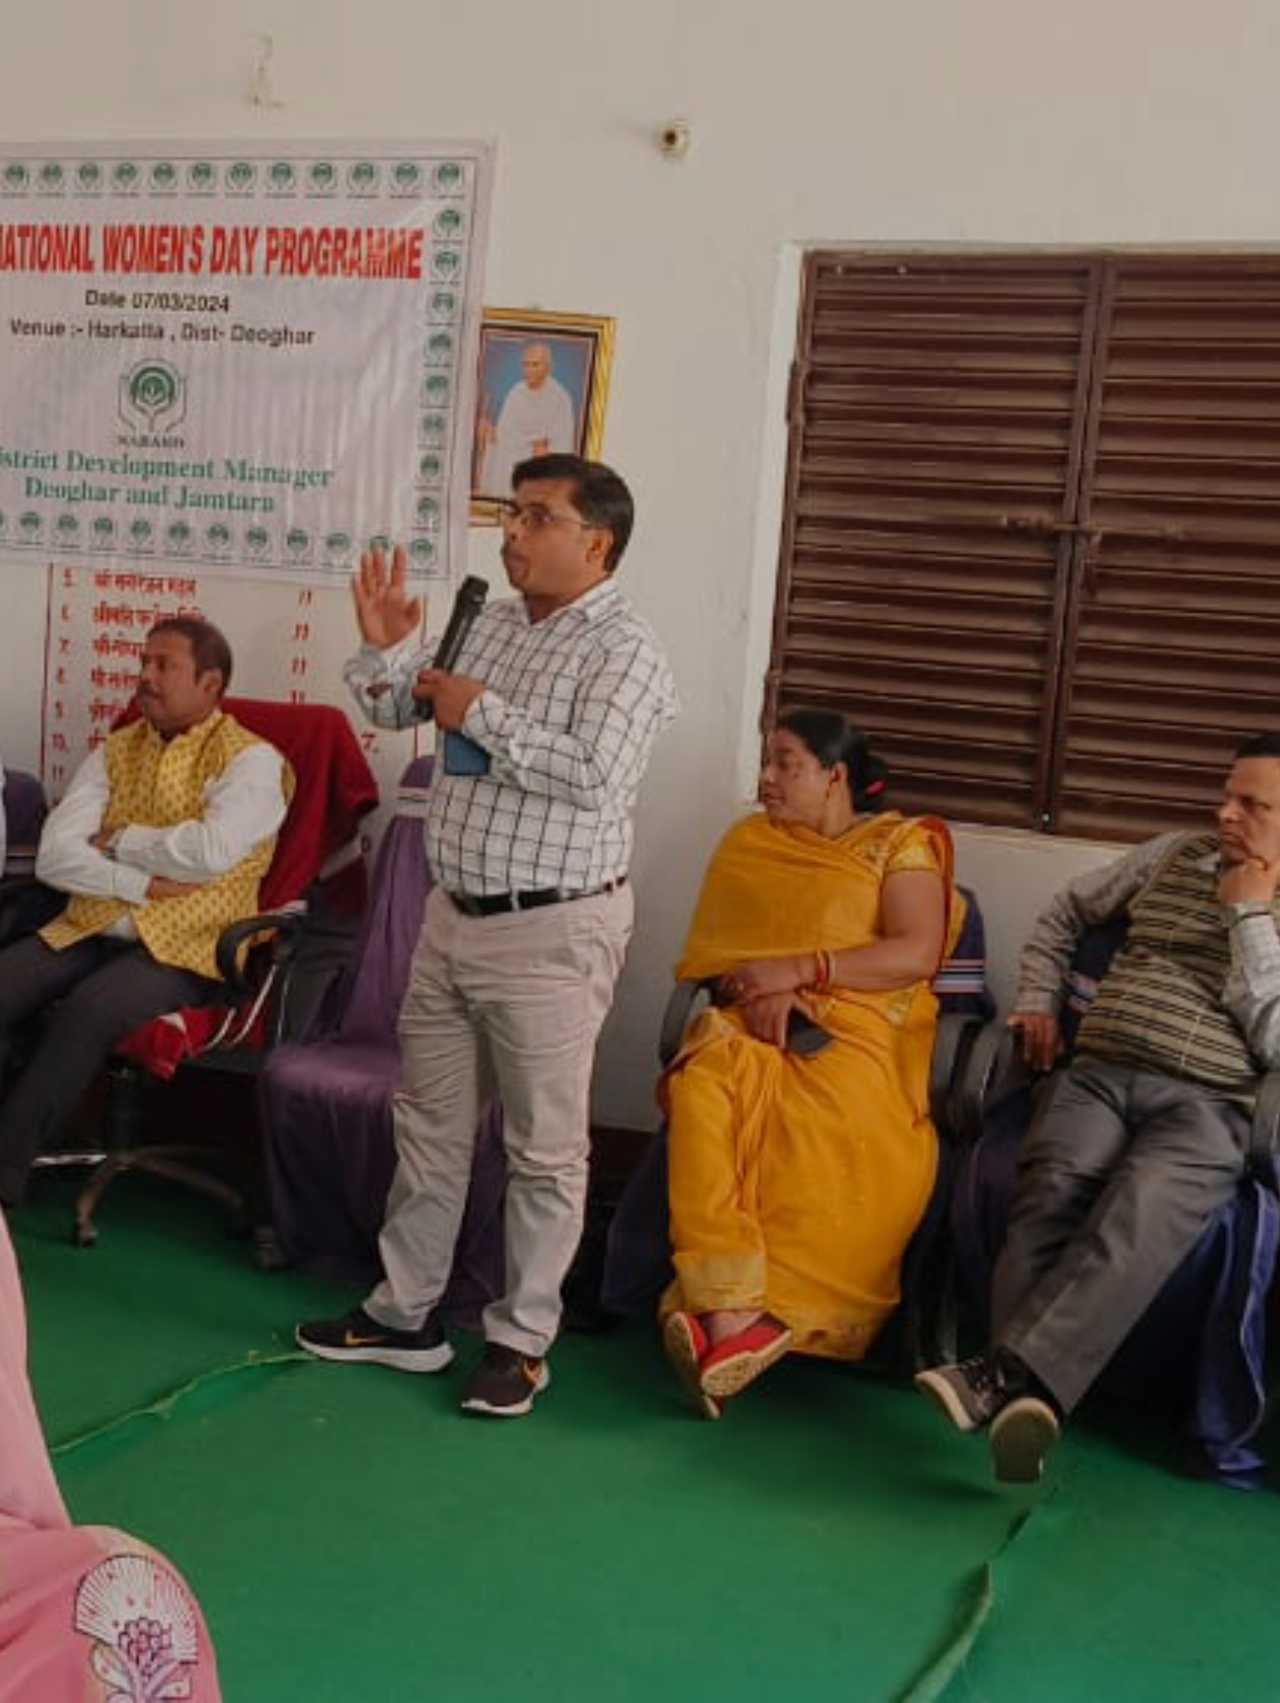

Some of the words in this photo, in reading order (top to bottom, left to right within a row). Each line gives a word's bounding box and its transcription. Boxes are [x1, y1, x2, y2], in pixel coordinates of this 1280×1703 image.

[102, 224, 204, 275] WOMEN'S
[210, 225, 259, 277] DAY
[265, 226, 424, 280] PROGRAMME
[85, 289, 126, 308] Date
[132, 291, 230, 313] 07/03/2024
[11, 318, 66, 337] Venue
[230, 324, 316, 348] Deoghar
[67, 449, 215, 482] Development
[223, 458, 335, 491] Manager
[25, 475, 122, 503] Deoghar
[126, 485, 167, 505] and
[173, 485, 276, 512] Jamtara
